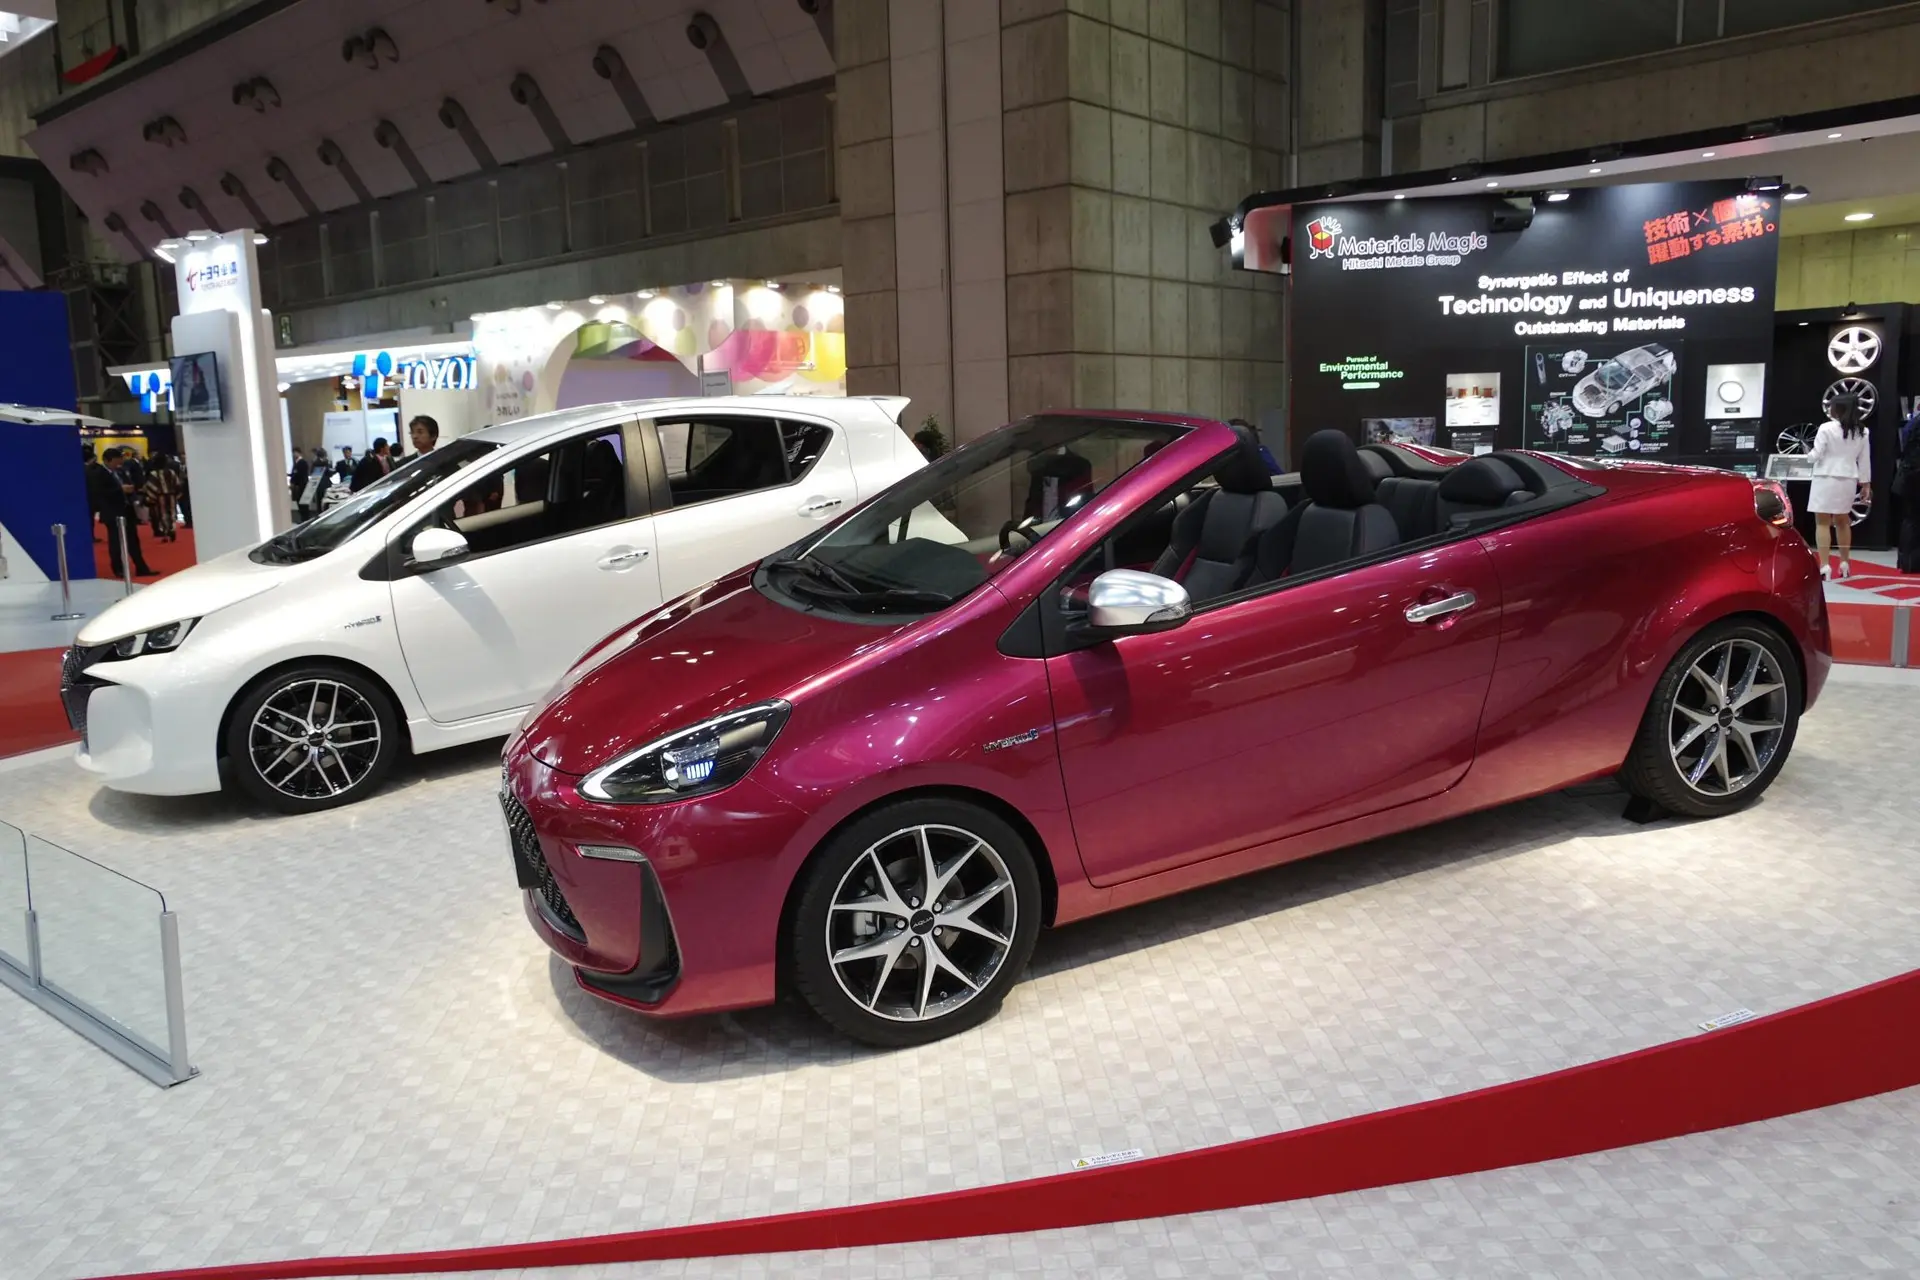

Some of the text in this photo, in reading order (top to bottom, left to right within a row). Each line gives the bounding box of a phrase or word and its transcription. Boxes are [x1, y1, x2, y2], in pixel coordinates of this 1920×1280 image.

[1338, 233, 1425, 257] Materials
[1342, 254, 1461, 270] Hitachi Metals Group
[1478, 269, 1630, 291] Synergetic Effect of
[1438, 286, 1755, 316] Technology and Uniqueness
[1514, 316, 1686, 336] Outstanding Materials
[1320, 361, 1389, 372] Environmental
[1340, 370, 1404, 380] Performance
[911, 916, 934, 929] AQUA
